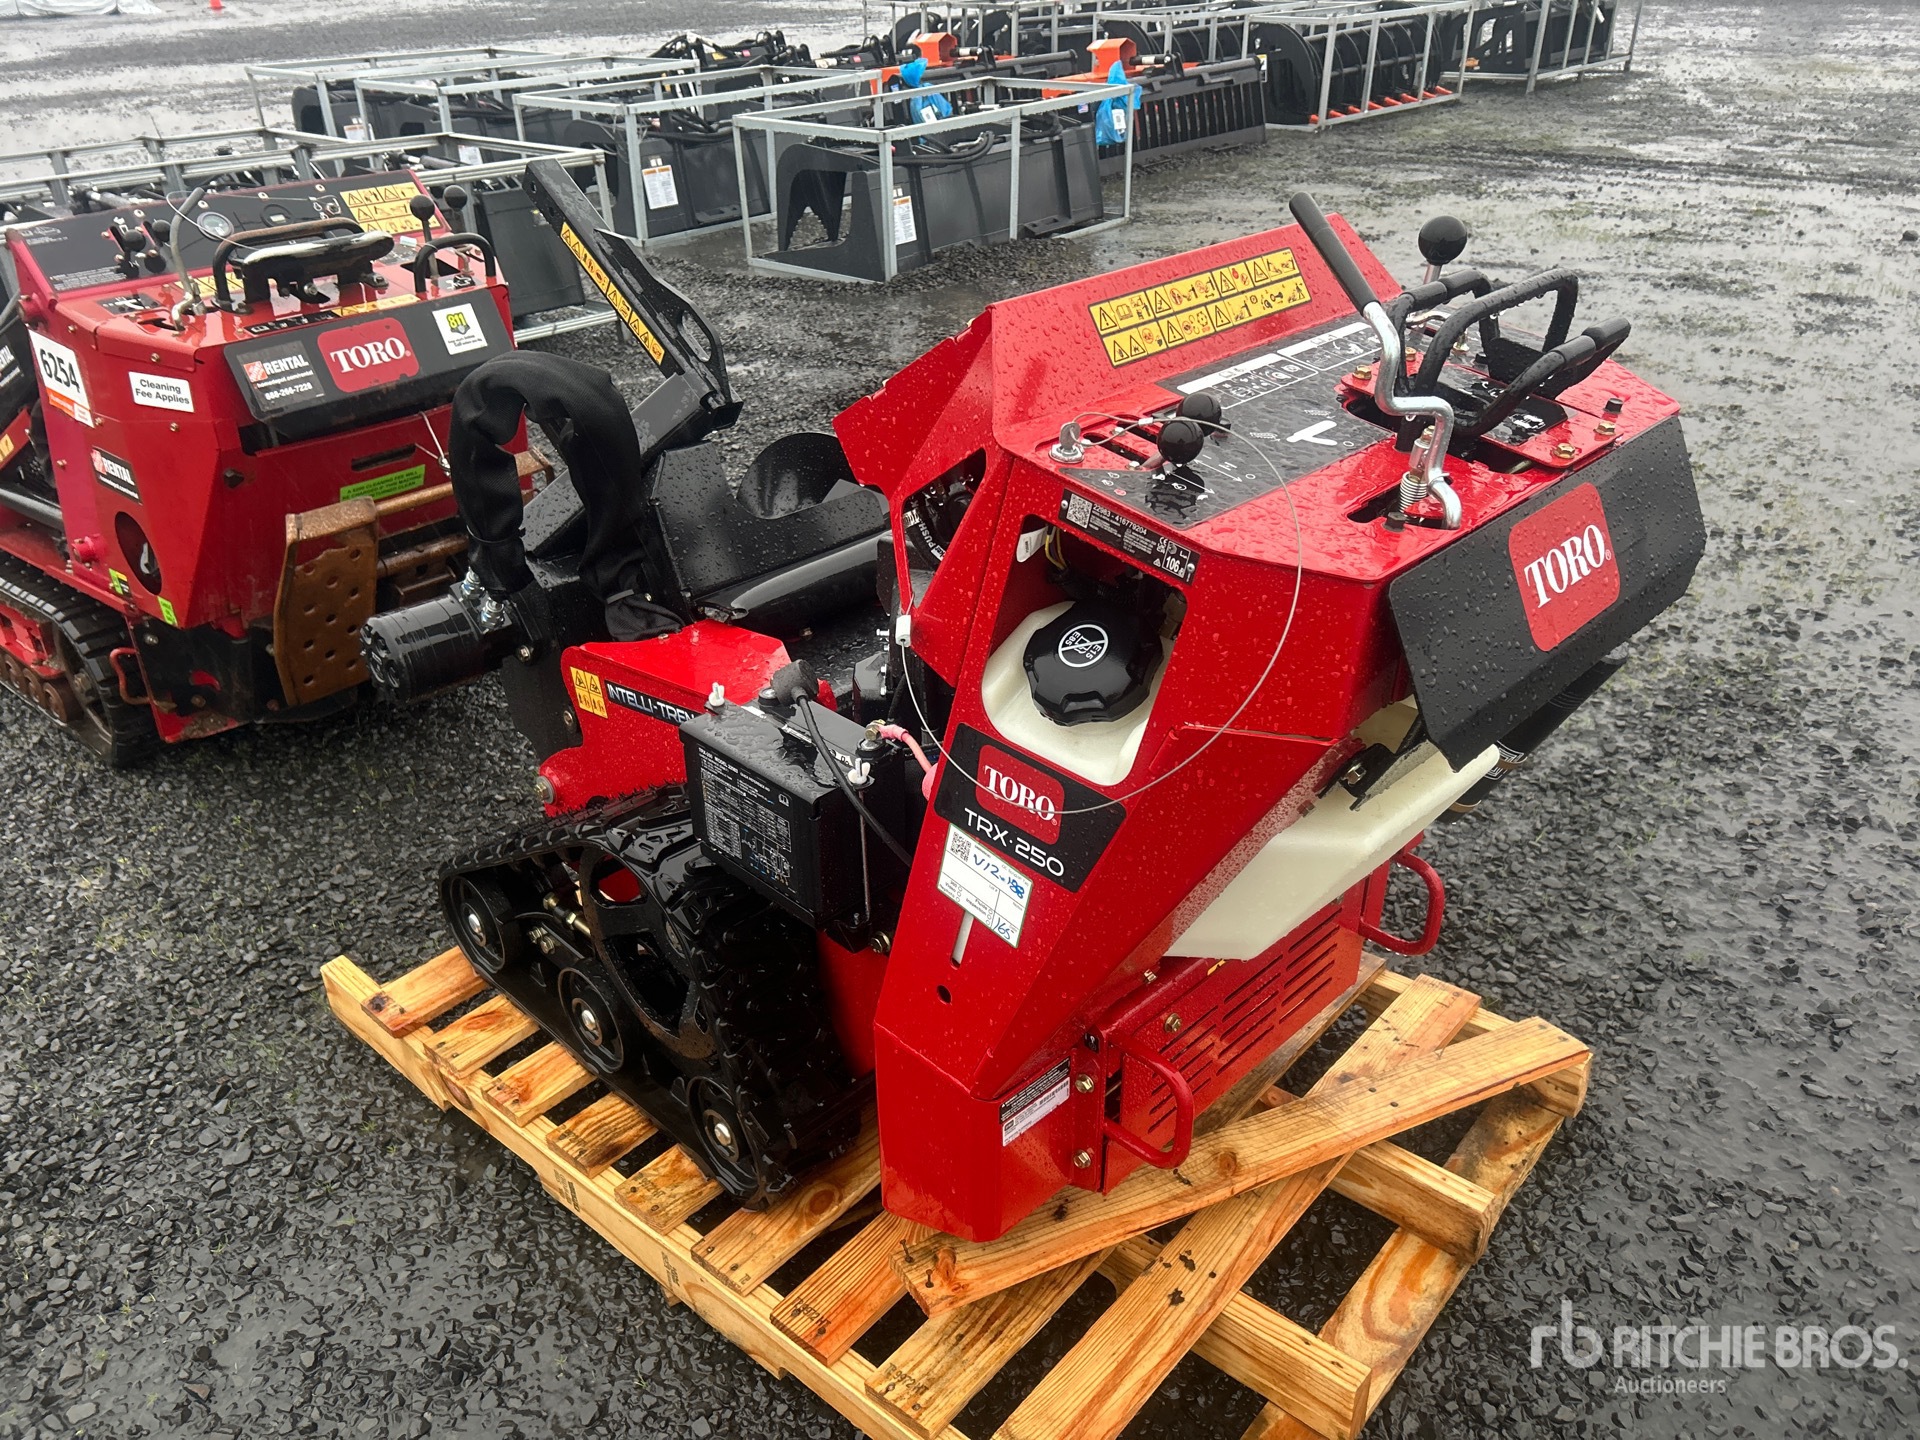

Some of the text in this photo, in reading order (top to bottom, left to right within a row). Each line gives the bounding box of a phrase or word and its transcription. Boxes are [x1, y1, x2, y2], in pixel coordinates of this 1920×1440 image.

[446, 312, 467, 330] 811
[329, 337, 405, 374] TORO
[40, 348, 80, 394] 6254
[264, 354, 309, 376] RENTAL
[139, 378, 181, 395] Cleaning
[135, 388, 190, 405] Fee Applies
[1165, 555, 1180, 573] 106
[1523, 524, 1606, 609] TORO
[1065, 631, 1081, 646] E85
[1085, 644, 1102, 660] E15
[984, 765, 1055, 821] TORO
[893, 1370, 916, 1389] 9972
